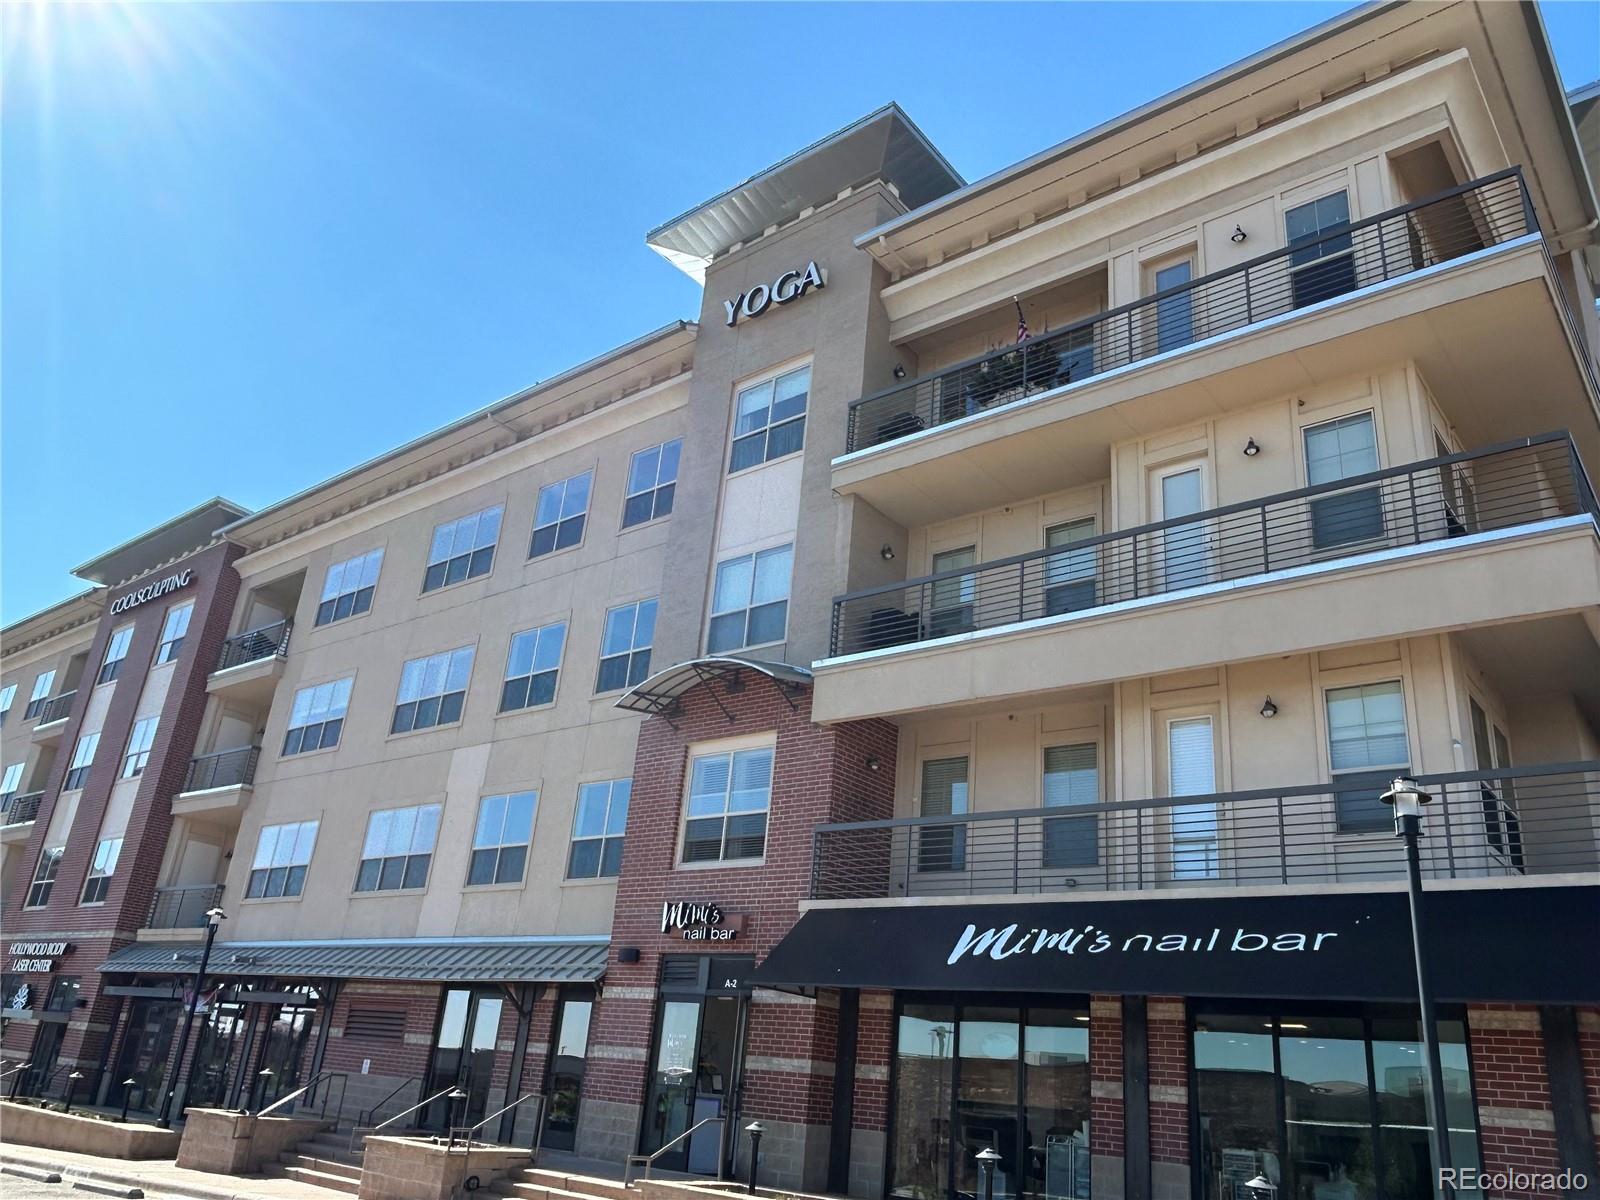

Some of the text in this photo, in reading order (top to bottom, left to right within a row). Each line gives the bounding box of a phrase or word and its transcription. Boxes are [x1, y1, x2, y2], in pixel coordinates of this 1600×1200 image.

[723, 261, 823, 326] YOGA
[110, 568, 191, 615] COOLSCULPTING
[661, 901, 720, 933] Mimi's
[683, 926, 735, 940] nail bar
[947, 923, 1338, 965] Mimi's nail bar
[8, 942, 48, 956] HOLLYWOOD
[12, 959, 52, 972] LASER CENTER
[724, 979, 738, 988] A-2
